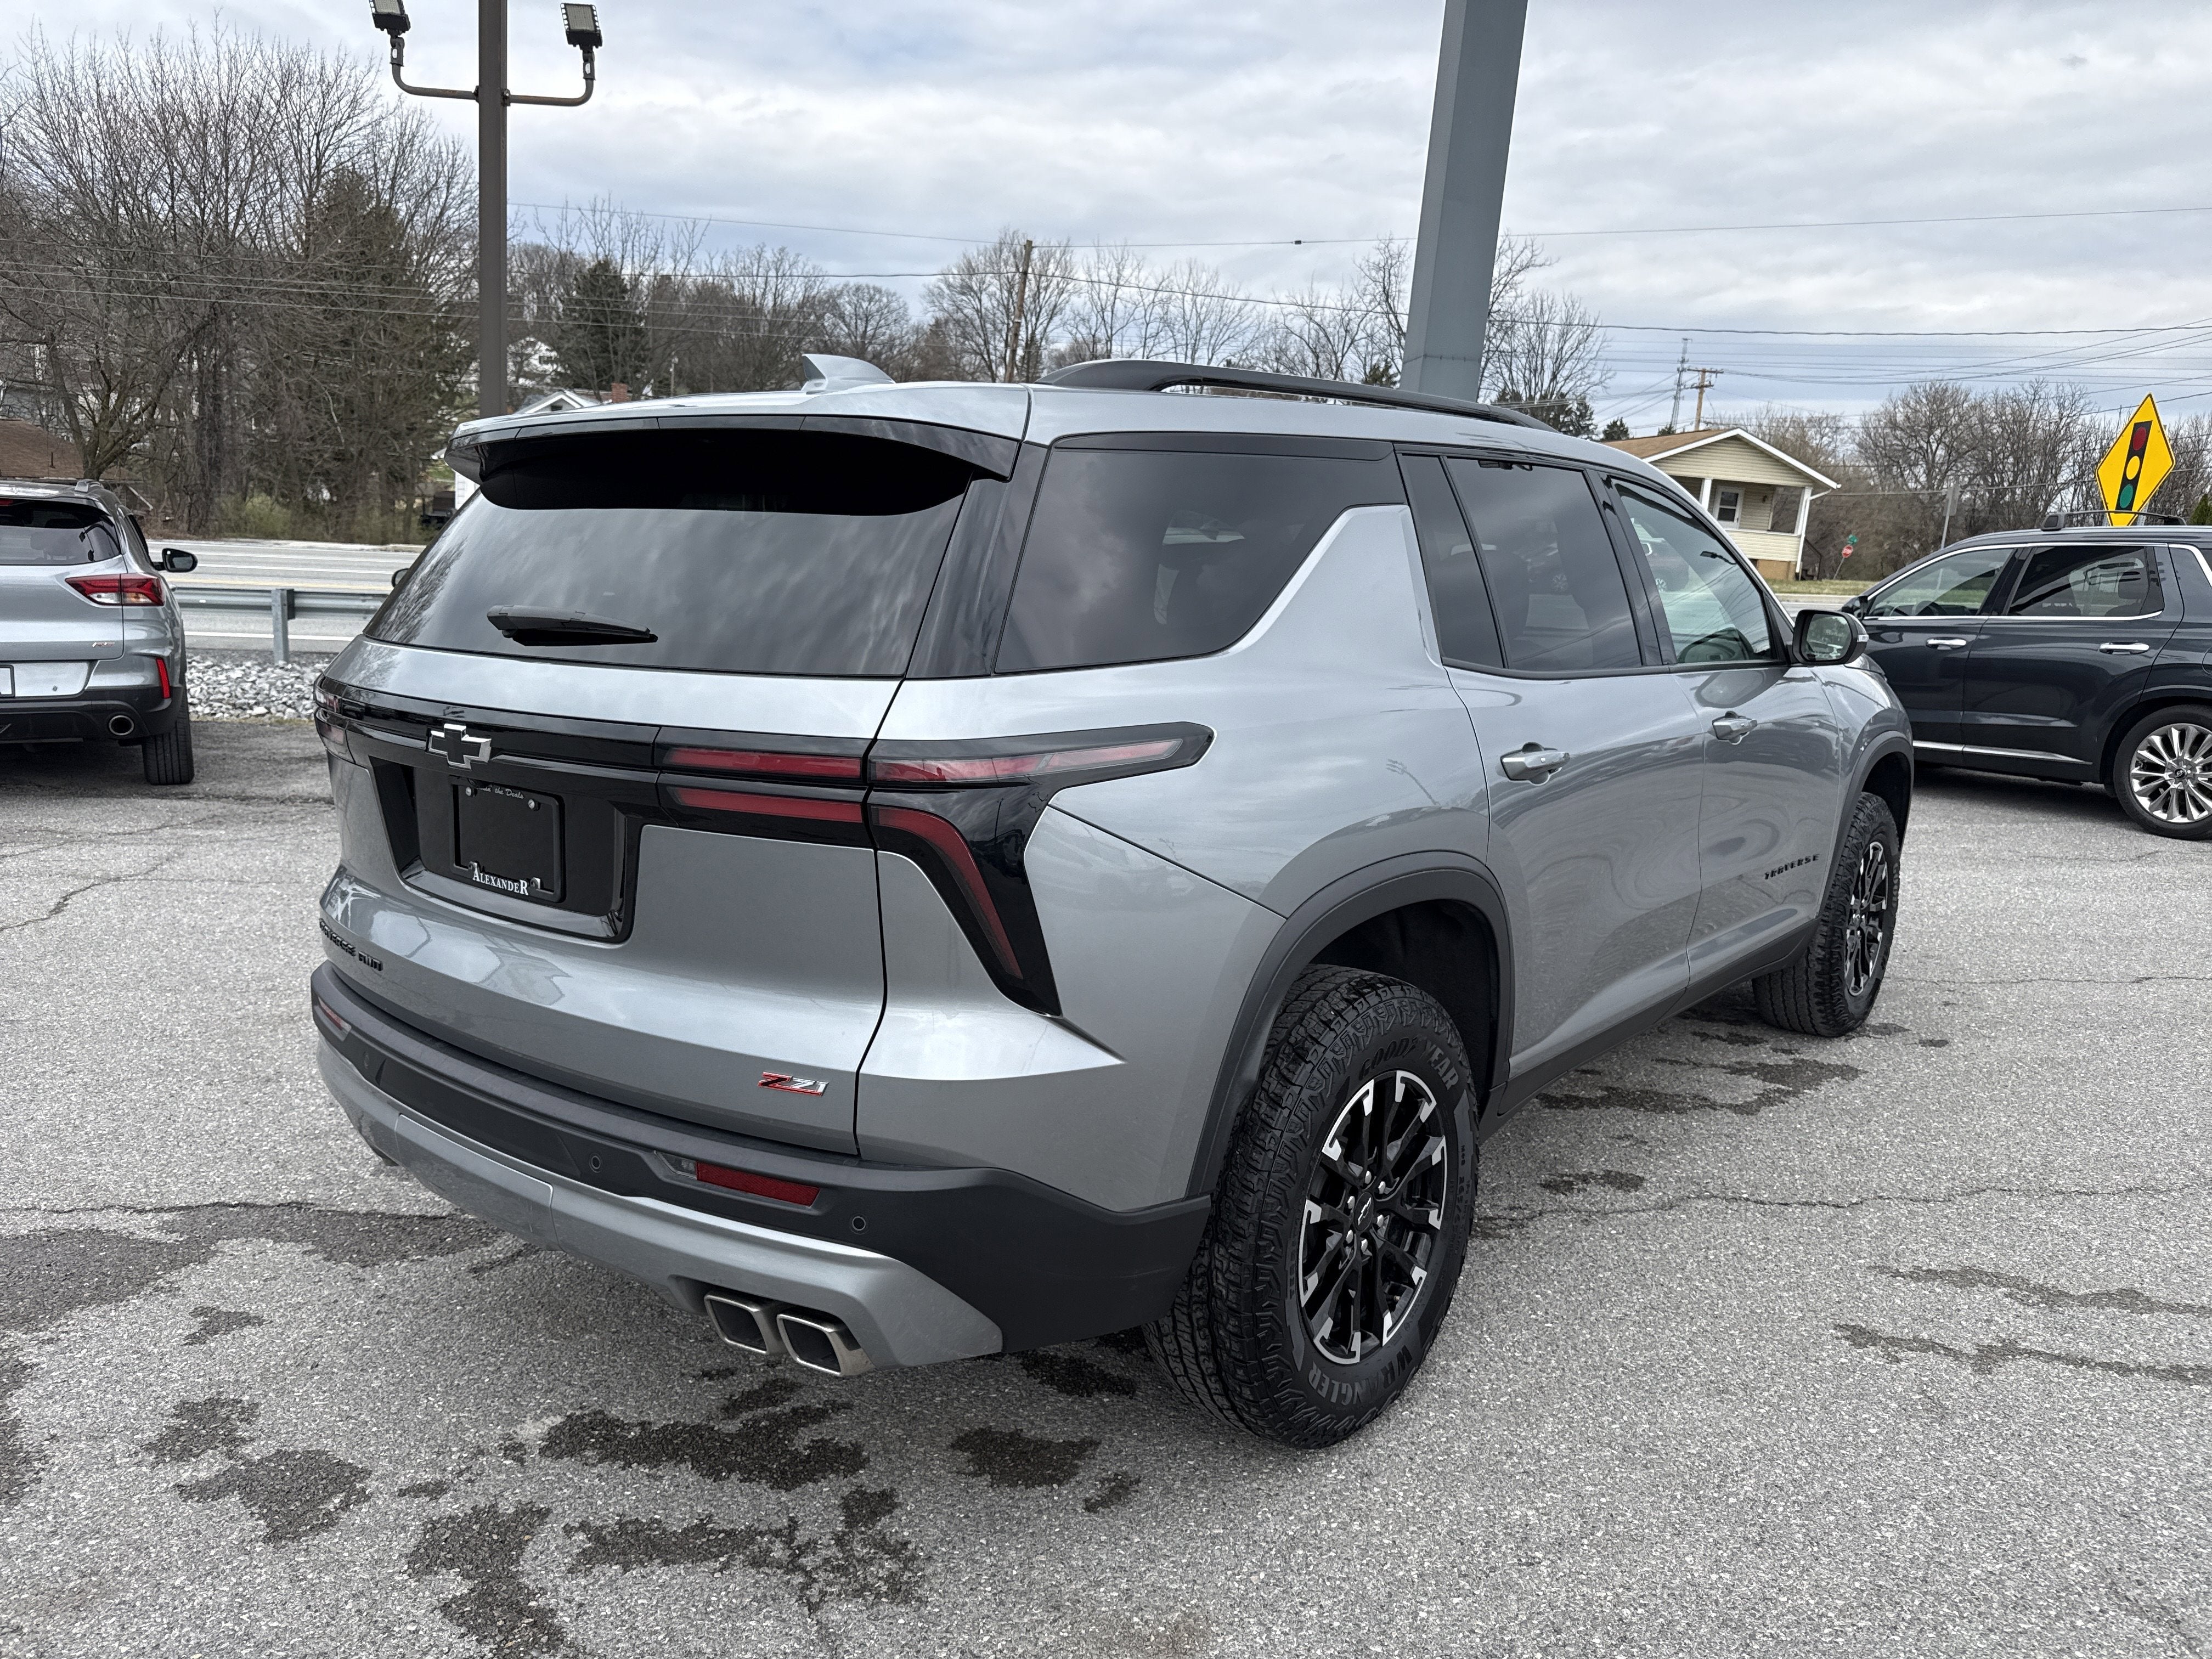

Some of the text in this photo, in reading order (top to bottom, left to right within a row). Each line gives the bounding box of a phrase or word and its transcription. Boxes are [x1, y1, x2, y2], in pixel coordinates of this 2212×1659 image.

[494, 787, 504, 795] the
[1764, 854, 1820, 879] TRAVERSE
[472, 867, 529, 895] ALEXANDER
[758, 1071, 829, 1097] Z71
[1308, 1345, 1413, 1406] WRANGLER
